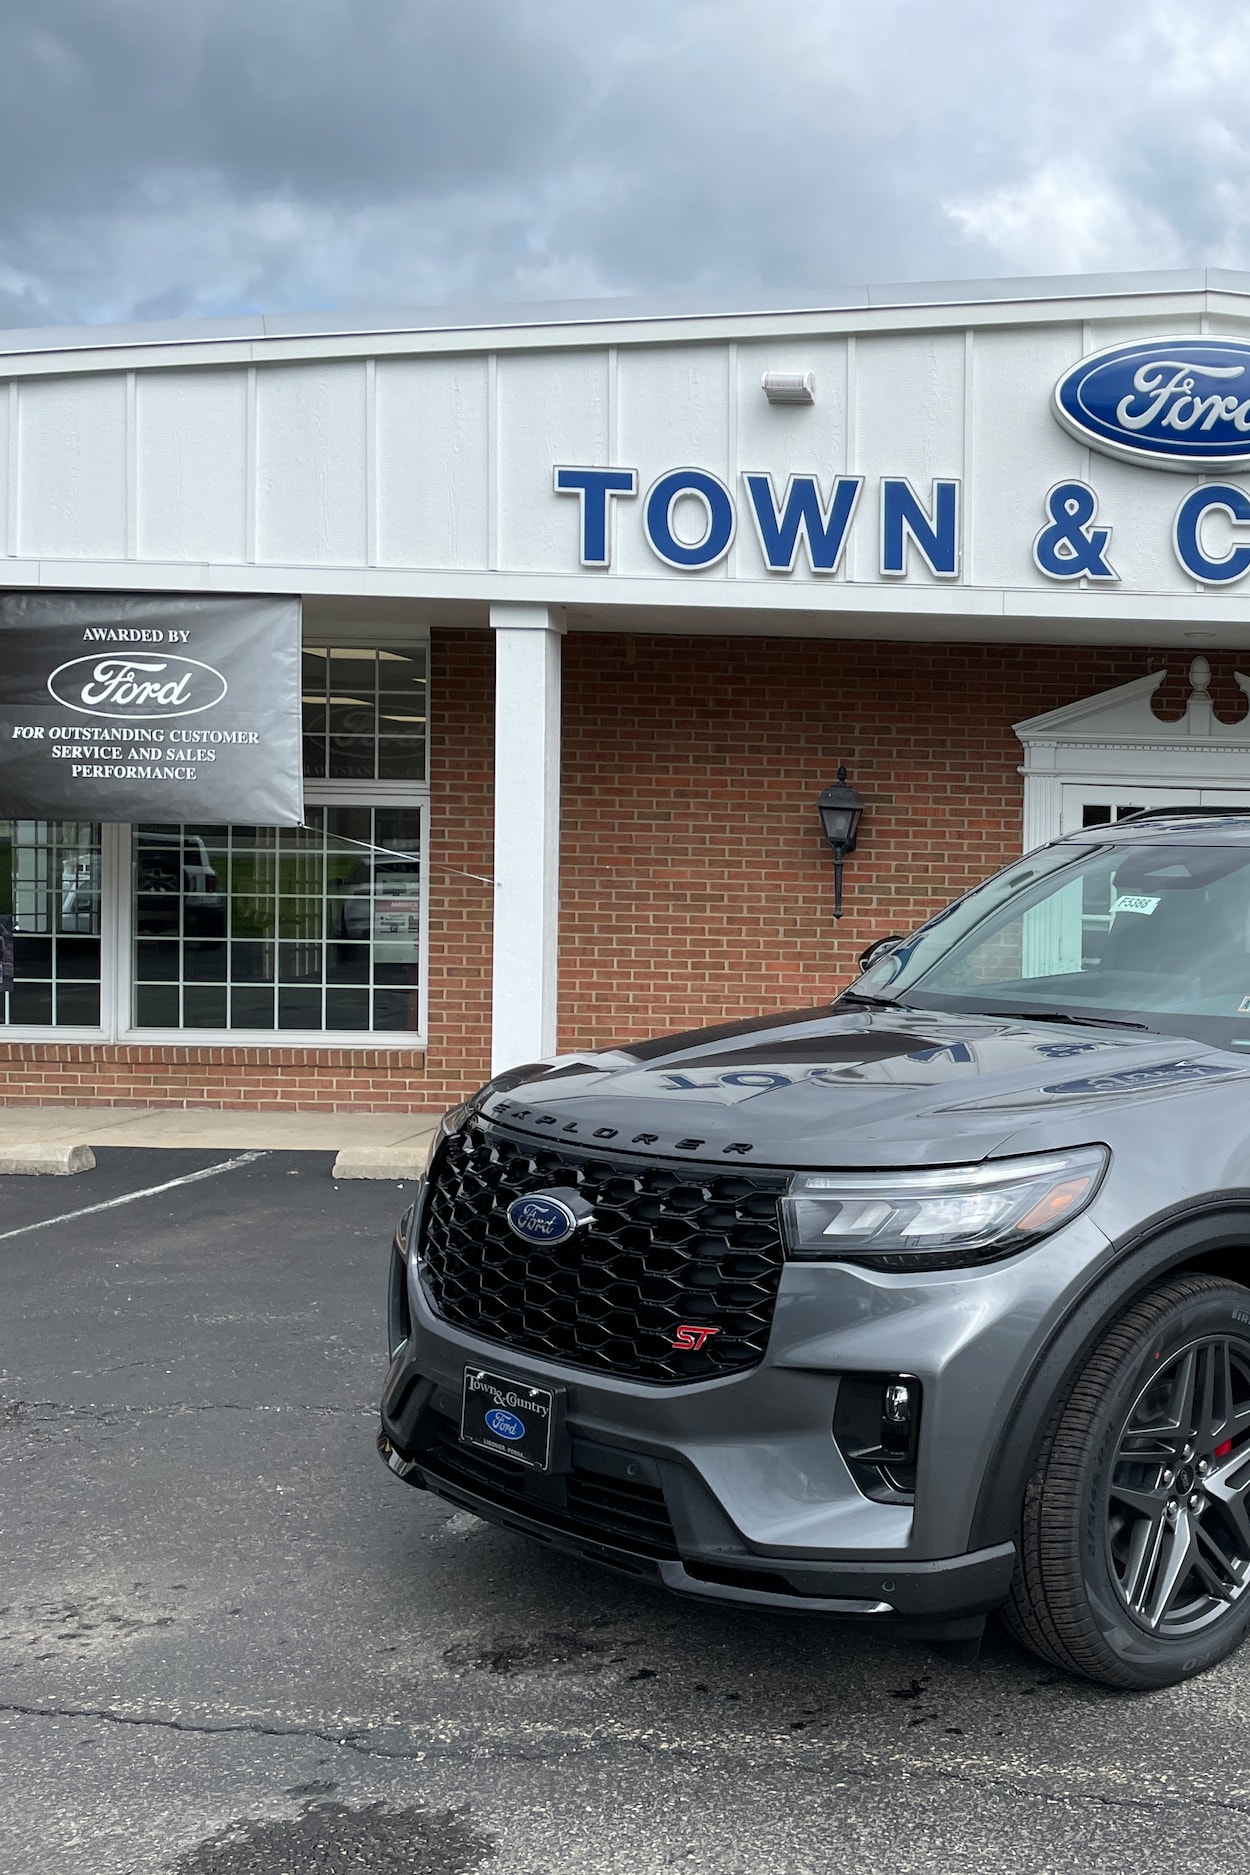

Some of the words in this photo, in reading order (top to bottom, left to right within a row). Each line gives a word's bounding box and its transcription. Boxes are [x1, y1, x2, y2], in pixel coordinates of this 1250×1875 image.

[553, 465, 961, 578] TOWN
[1033, 479, 1122, 582] &
[83, 628, 163, 643] AWARDED
[168, 630, 191, 643] BY
[80, 660, 193, 705] Ford
[12, 726, 45, 740] FOR
[49, 727, 165, 742] OUTSTANDING
[170, 730, 260, 745] CUSTOMER
[51, 745, 123, 760] SERVICE
[128, 747, 162, 761] AND
[166, 748, 216, 762] SALES
[72, 764, 197, 780] PERFORMANCE
[491, 1103, 753, 1155] EXPLORER
[518, 1204, 557, 1235] Ford
[672, 1325, 720, 1351] ST
[466, 1374, 497, 1395] Town
[493, 1390, 507, 1407] &
[506, 1392, 549, 1417] Country
[492, 1412, 517, 1435] Ford
